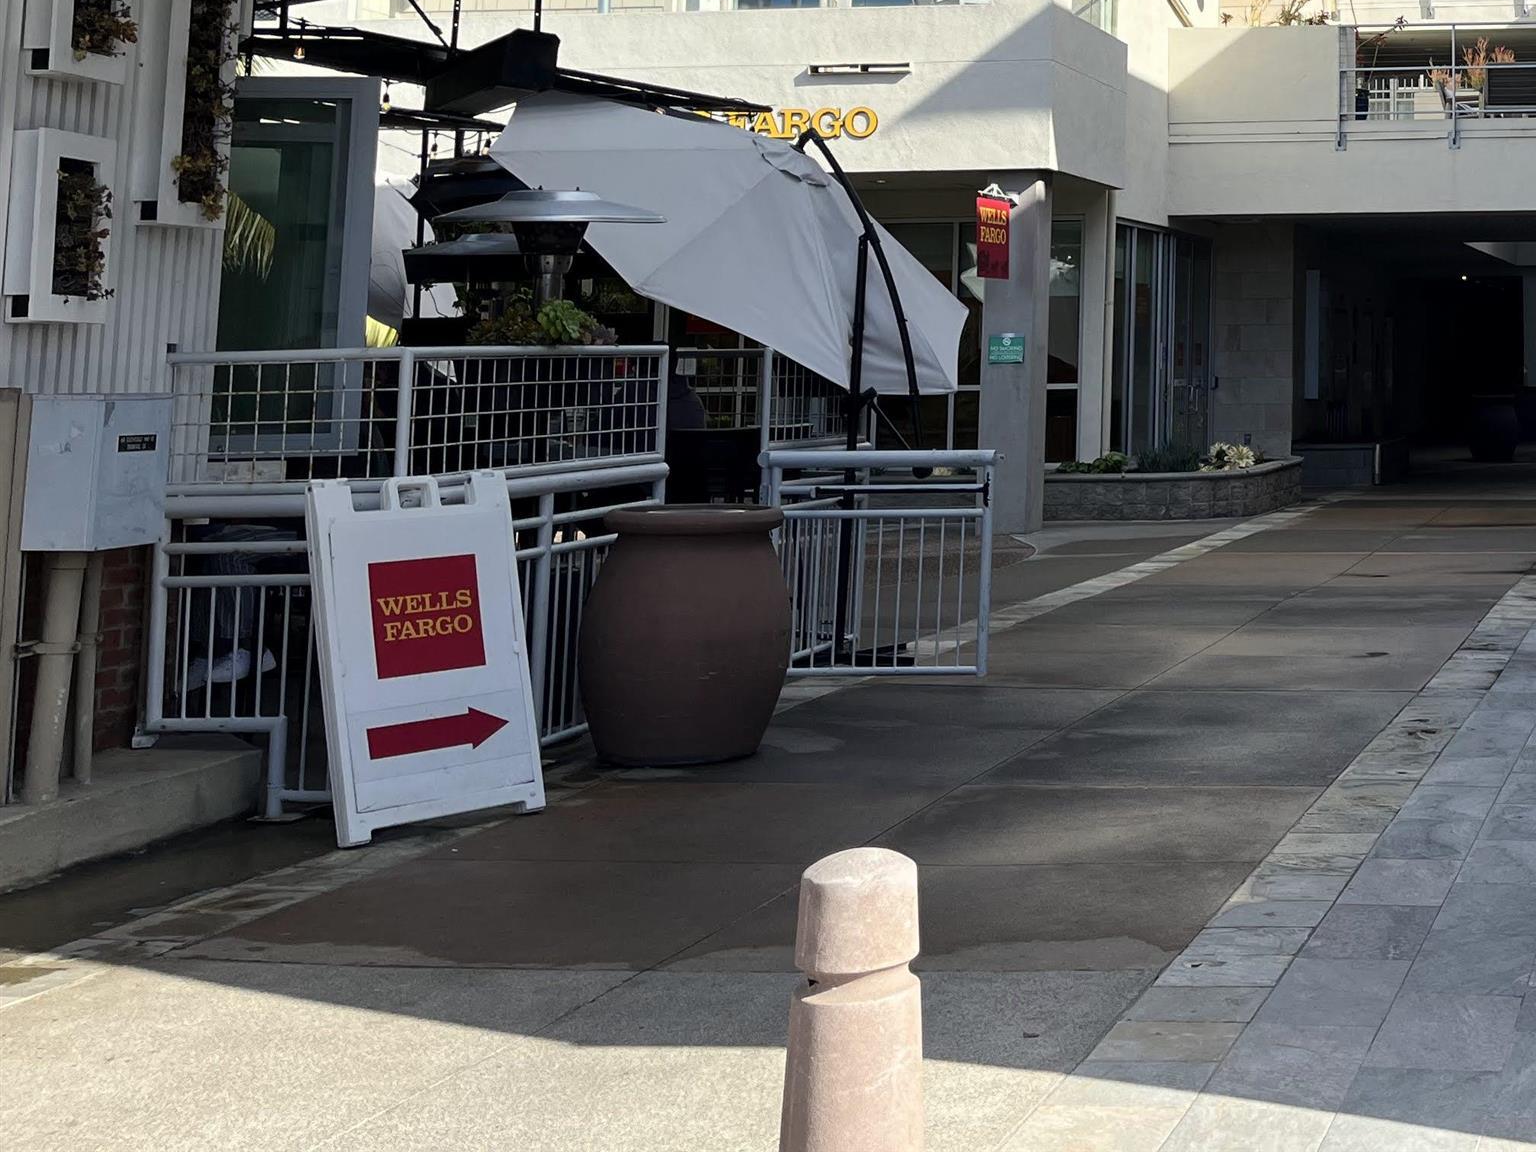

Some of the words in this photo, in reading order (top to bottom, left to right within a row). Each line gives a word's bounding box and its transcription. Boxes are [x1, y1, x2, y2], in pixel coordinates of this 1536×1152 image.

[979, 207, 1007, 226] WELLS
[980, 226, 1007, 244] FARGO
[376, 589, 472, 616] WELLS
[383, 614, 473, 642] FARGO
